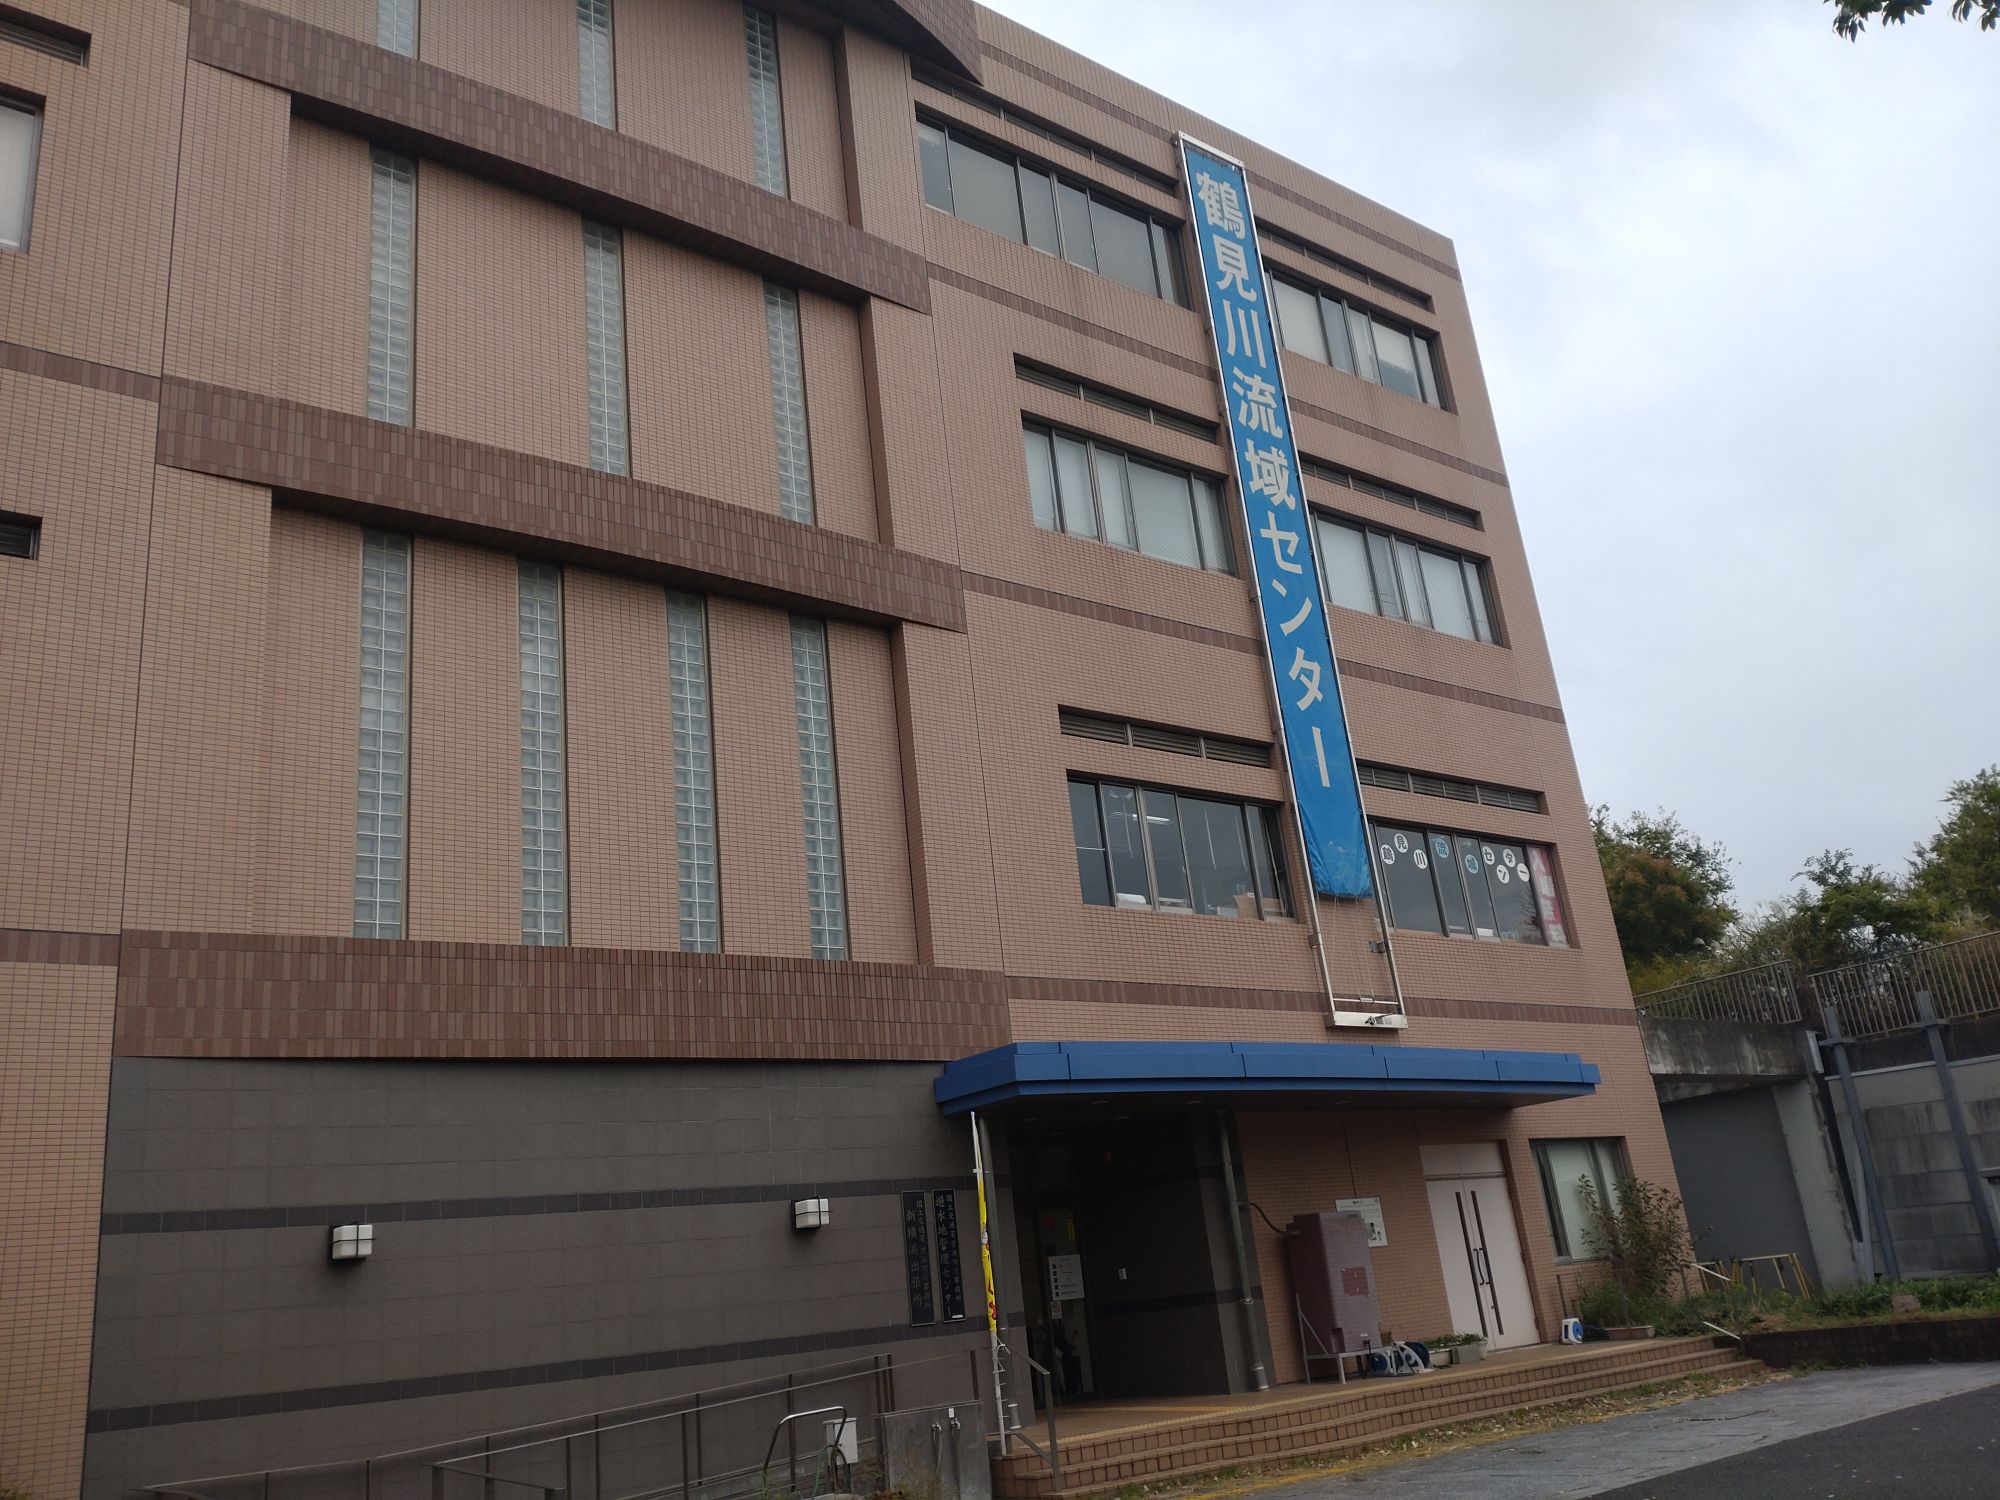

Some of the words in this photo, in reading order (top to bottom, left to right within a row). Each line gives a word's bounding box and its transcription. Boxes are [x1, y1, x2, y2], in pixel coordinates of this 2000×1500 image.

[1196, 171, 1330, 788] 鶴見川流域センター
[1381, 834, 1529, 883] 鶴見川流域センター
